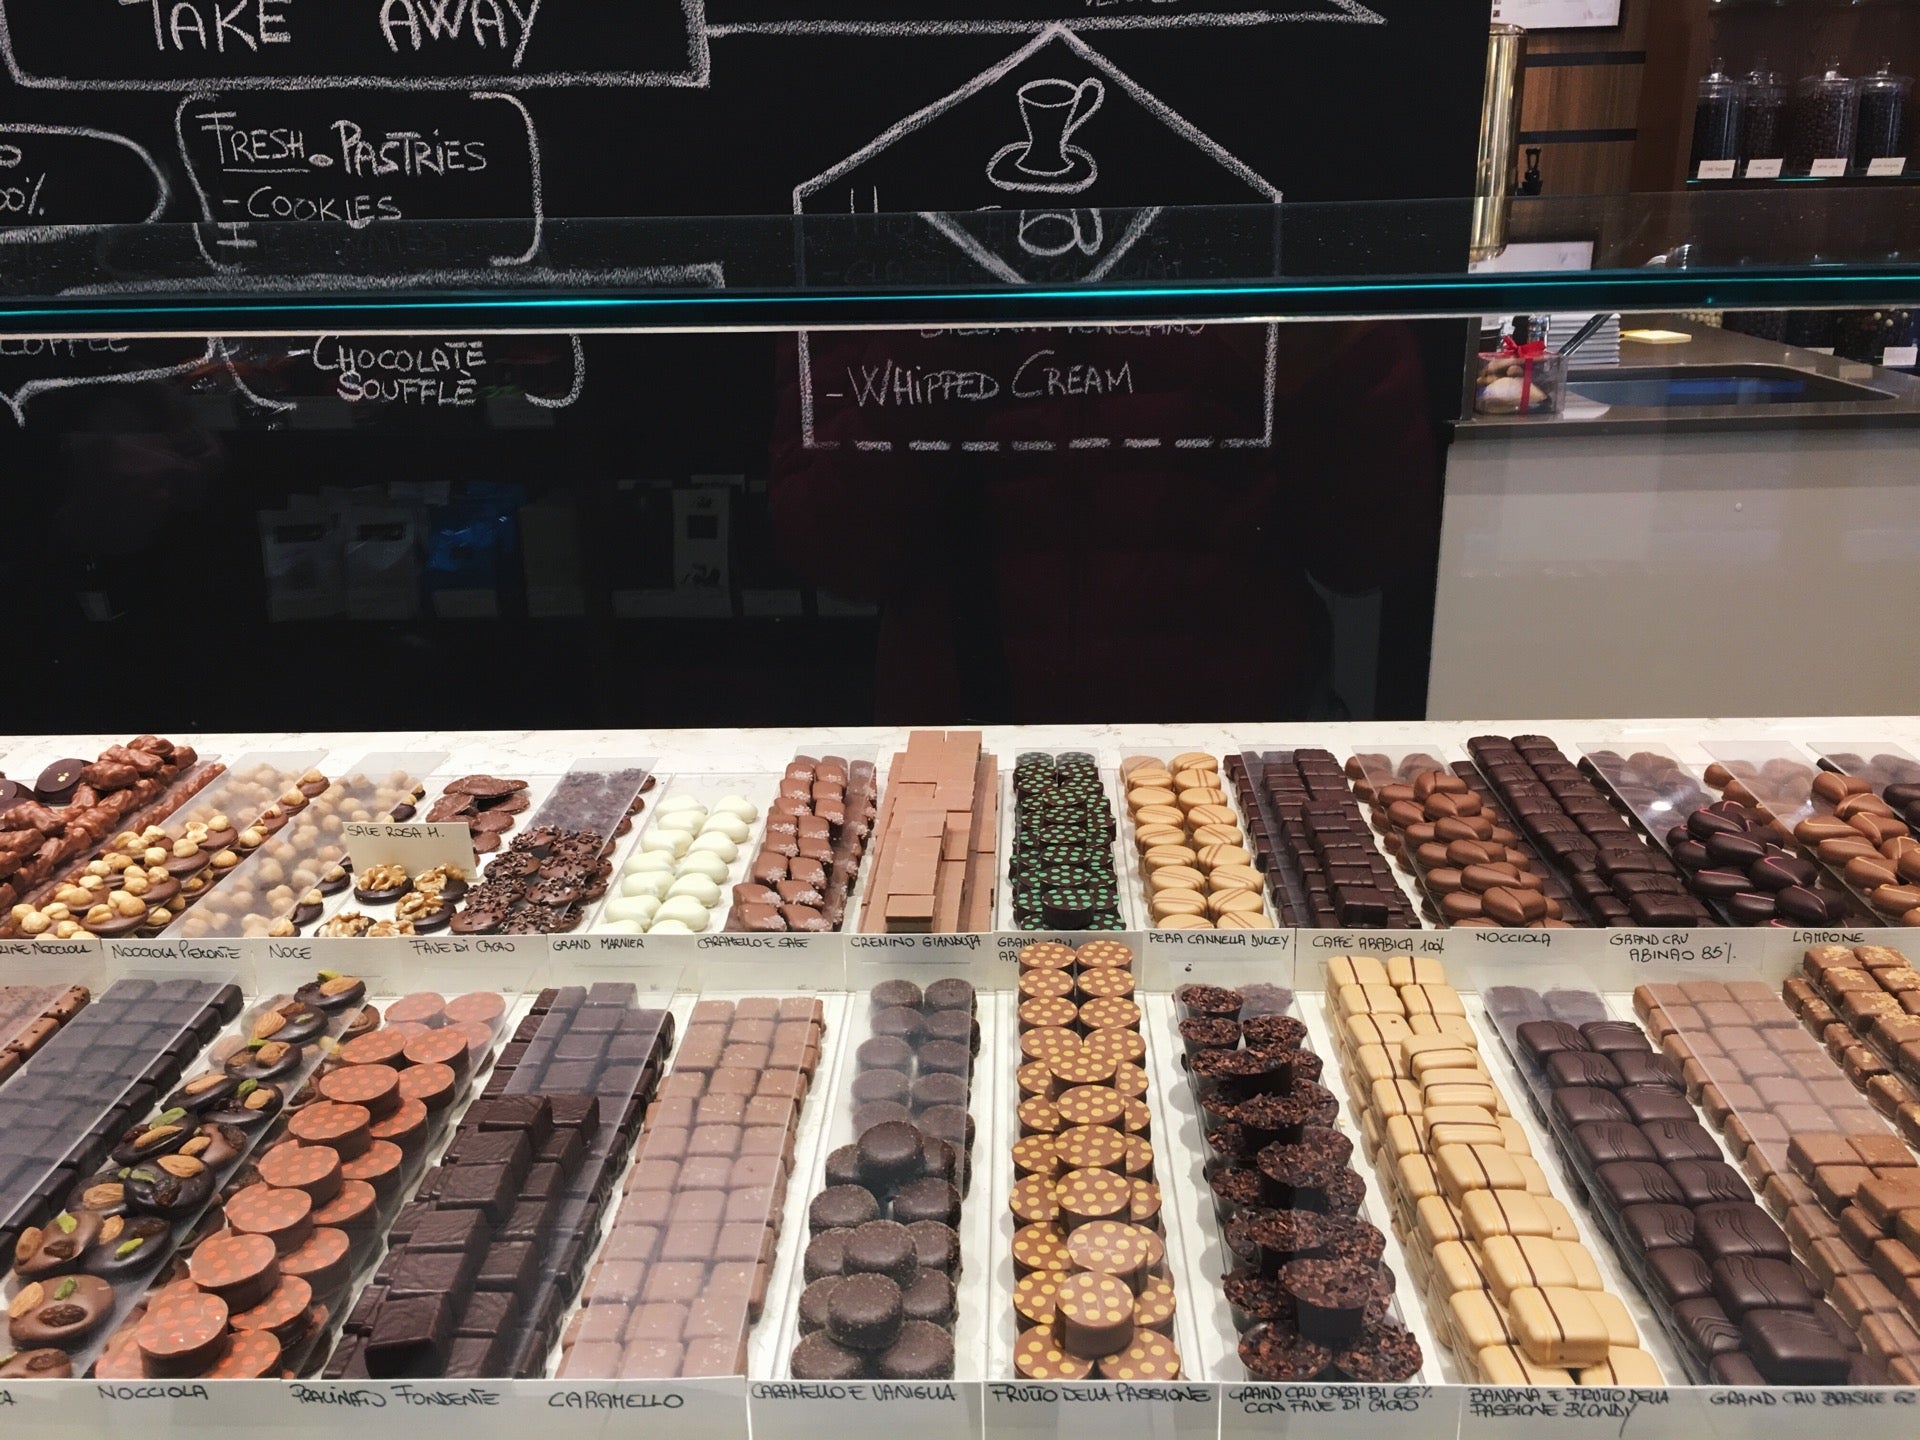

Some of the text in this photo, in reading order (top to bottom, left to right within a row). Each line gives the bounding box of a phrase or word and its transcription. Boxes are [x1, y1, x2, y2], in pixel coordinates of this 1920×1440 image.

[119, 0, 540, 69] TAKE AWAY
[1011, 349, 1134, 398] CREAM
[346, 825, 380, 836] SALE
[385, 825, 422, 838] ROSA
[553, 937, 645, 951] GRAND MARNIER
[850, 936, 915, 948] CREMINO
[1187, 934, 1246, 946] CANNELLA
[1358, 937, 1414, 952] ARABICA
[1475, 932, 1551, 947] NOCCIOLA
[1609, 933, 1689, 946] GRAND CRU
[1792, 931, 1865, 943] LAMPONE
[269, 943, 312, 960] NOCE
[409, 940, 451, 956] FAVE
[1629, 948, 1694, 962] ABINAO
[98, 1384, 209, 1401] NOCCIOLA
[848, 1386, 866, 1400] E
[1115, 1382, 1211, 1403] PASSIONE
[1228, 1386, 1282, 1402] GRAND
[1284, 1387, 1317, 1399] CRU
[1469, 1387, 1541, 1404] BANANA
[1709, 1391, 1777, 1407] GRAND
[548, 1392, 684, 1409] CARAMELLO
[1244, 1400, 1286, 1414] CON
[1469, 1402, 1558, 1418] PASSIONE
